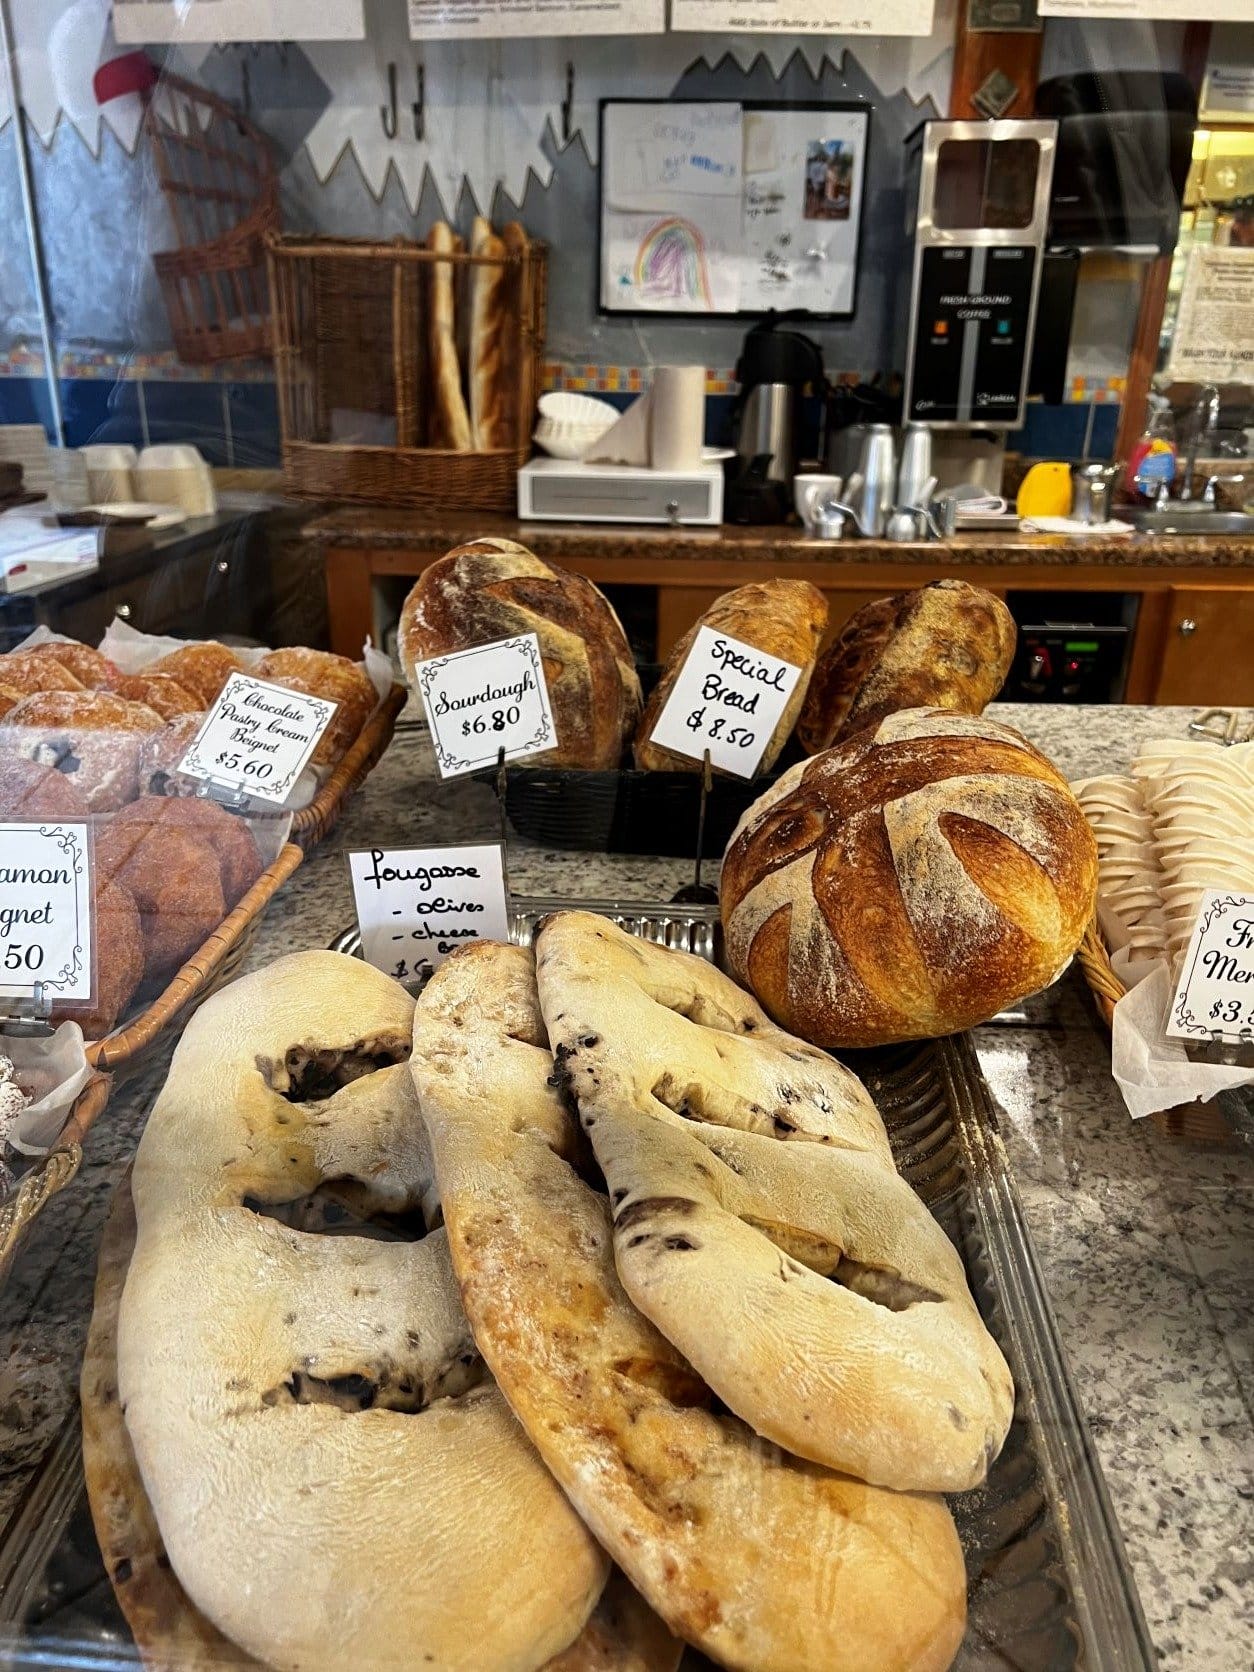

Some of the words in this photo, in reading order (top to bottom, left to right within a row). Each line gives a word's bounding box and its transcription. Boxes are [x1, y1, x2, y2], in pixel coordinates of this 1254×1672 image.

[711, 640, 787, 692] Special
[242, 692, 305, 722] Chocolate
[434, 670, 536, 717] Sourdough
[702, 674, 760, 714] Bread
[220, 702, 261, 733] Pastry
[264, 719, 309, 743] Cream
[461, 706, 520, 737] $6.80
[229, 727, 280, 753] Beignet
[215, 751, 273, 778] $5.60
[0, 867, 72, 884] amon
[0, 902, 55, 938] gnet
[416, 897, 484, 914] olives
[411, 921, 479, 940] cheese
[1203, 950, 1254, 983] Mer
